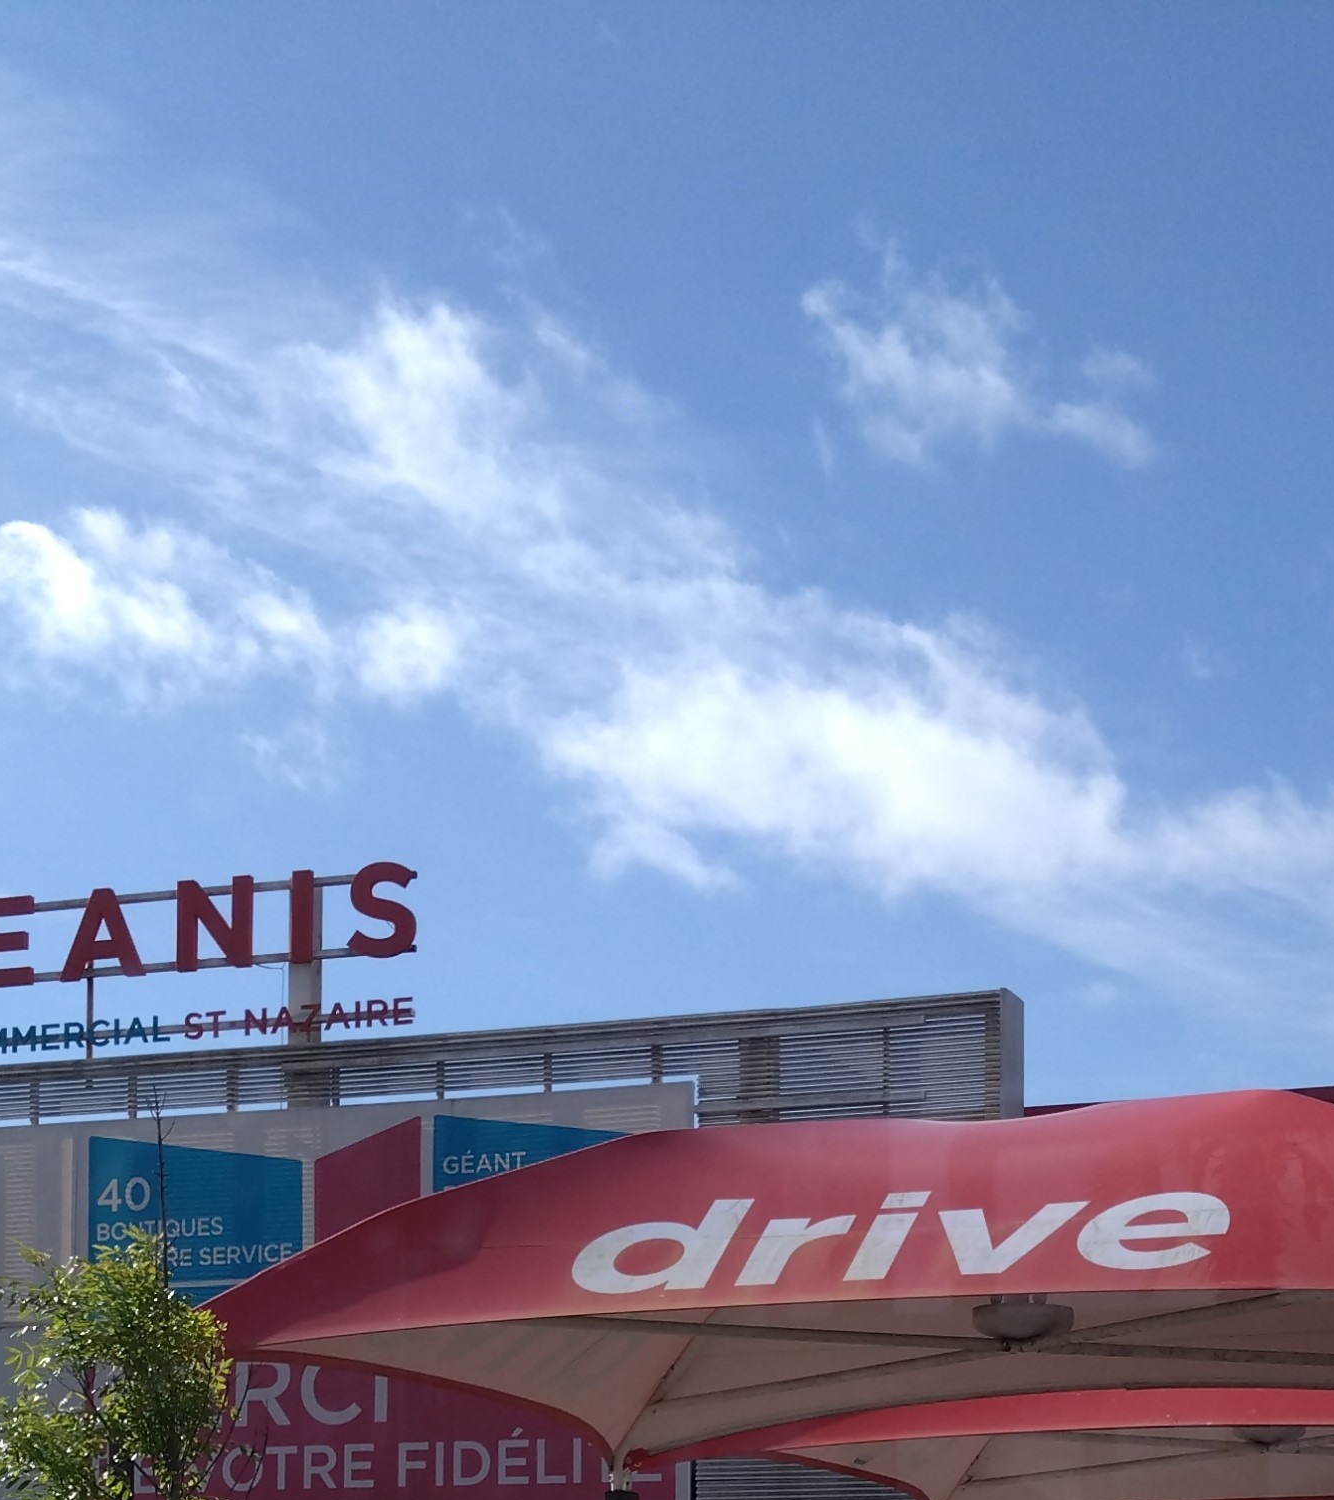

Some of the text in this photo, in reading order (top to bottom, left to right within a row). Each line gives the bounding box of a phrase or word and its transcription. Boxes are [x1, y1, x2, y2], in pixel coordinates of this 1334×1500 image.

[443, 1149, 526, 1175] GÉANT
[97, 1176, 150, 1212] 40
[571, 1191, 1230, 1295] drive
[397, 1427, 662, 1487] FIDÉLI
